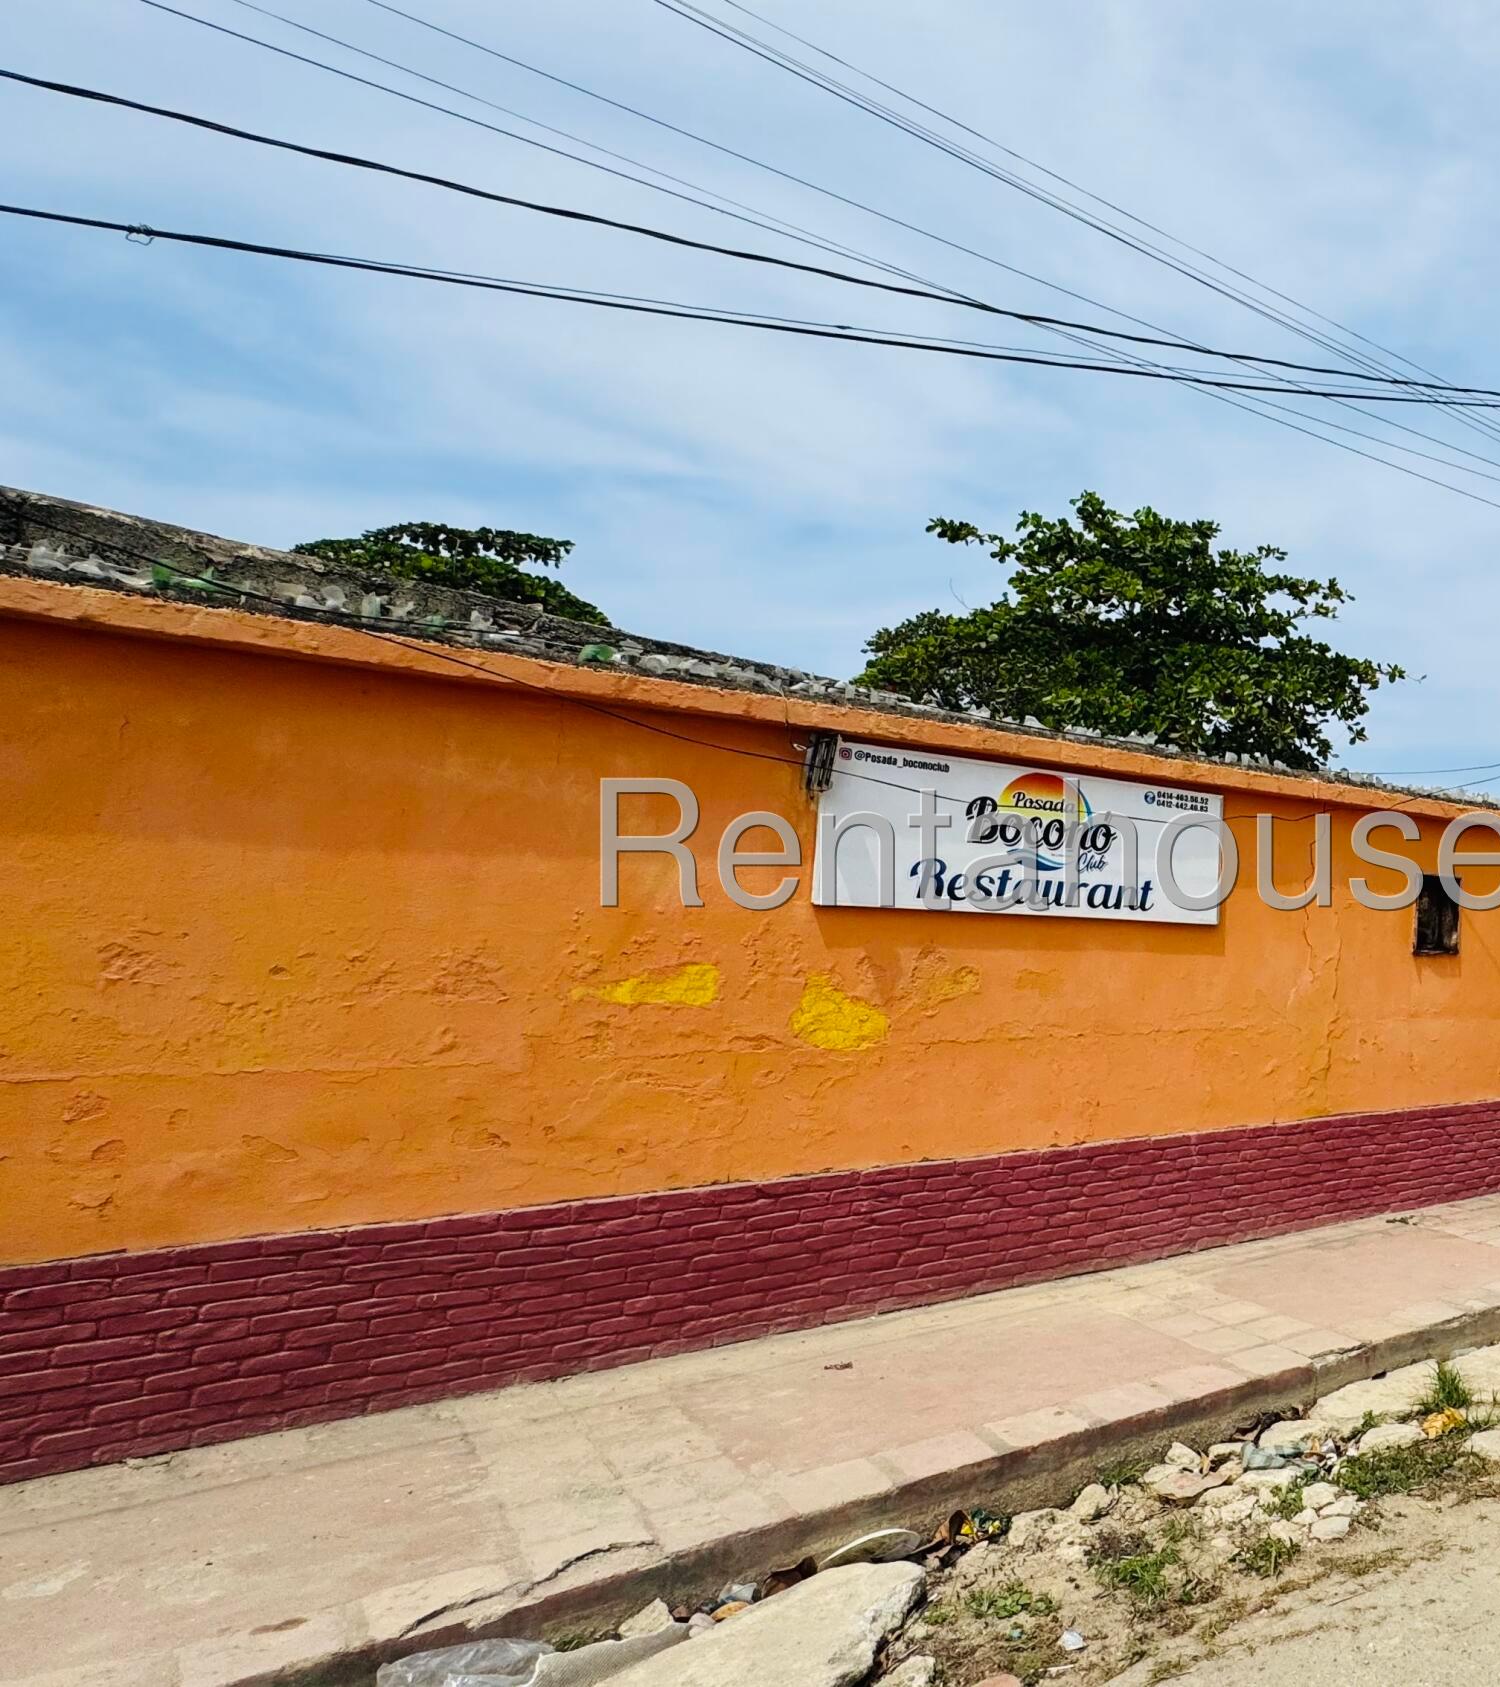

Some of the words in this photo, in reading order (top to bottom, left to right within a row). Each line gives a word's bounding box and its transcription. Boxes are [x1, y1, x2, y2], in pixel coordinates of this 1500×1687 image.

[854, 750, 950, 773] @Posada_boconoclub
[1012, 791, 1076, 814] Posada
[1077, 852, 1108, 873] Club
[910, 857, 1154, 911] Restaurant
